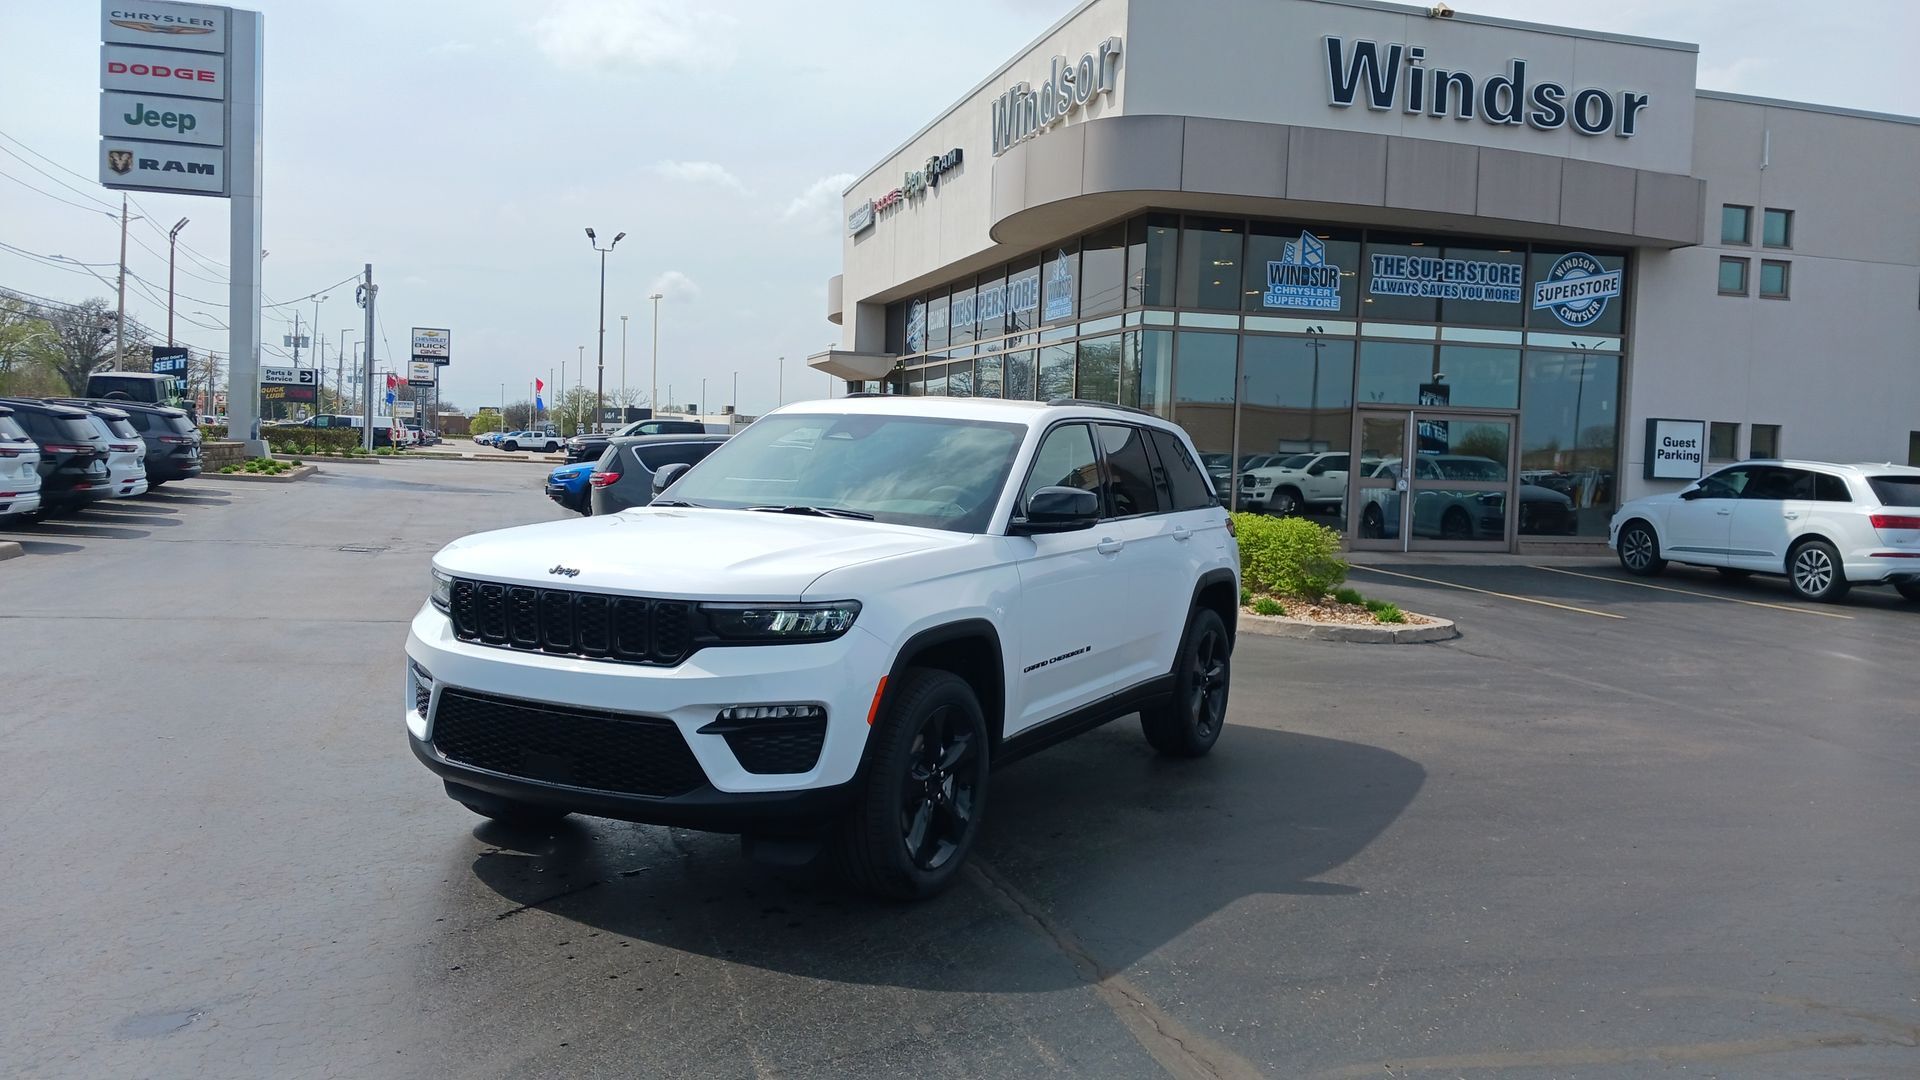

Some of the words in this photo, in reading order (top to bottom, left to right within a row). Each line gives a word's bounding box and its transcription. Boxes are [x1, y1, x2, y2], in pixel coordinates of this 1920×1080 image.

[111, 10, 214, 27] CHRYSLER
[108, 62, 215, 83] DODGE
[1322, 34, 1649, 138] Windsor
[991, 36, 1123, 158] Windsor
[124, 103, 196, 134] Jeep
[139, 158, 215, 176] RAM
[1269, 264, 1338, 288] WINDSOR
[1373, 256, 1406, 277] THE
[1408, 257, 1520, 284] SUPERSTORE
[1555, 257, 1596, 277] WINDSOR
[1274, 286, 1331, 296] CHRYSLER
[1372, 280, 1418, 295] ALWAYS
[1421, 282, 1459, 297] SAVES
[1461, 285, 1483, 299] YOU
[1484, 287, 1520, 301] MORE!
[1538, 277, 1618, 302] SUPERSTORE
[965, 276, 1038, 325] SUPERSTORE
[1267, 295, 1338, 307] SUPERSTORE
[1560, 301, 1600, 322] CHRYSLER
[153, 360, 173, 372] SEE
[175, 358, 187, 369] IT
[261, 386, 285, 394] QUICK
[1663, 436, 1696, 448] Guest
[1657, 449, 1700, 463] Parking
[549, 564, 580, 578] Jeep
[1024, 660, 1048, 673] GRAND
[1049, 648, 1085, 664] CHEROKEE
